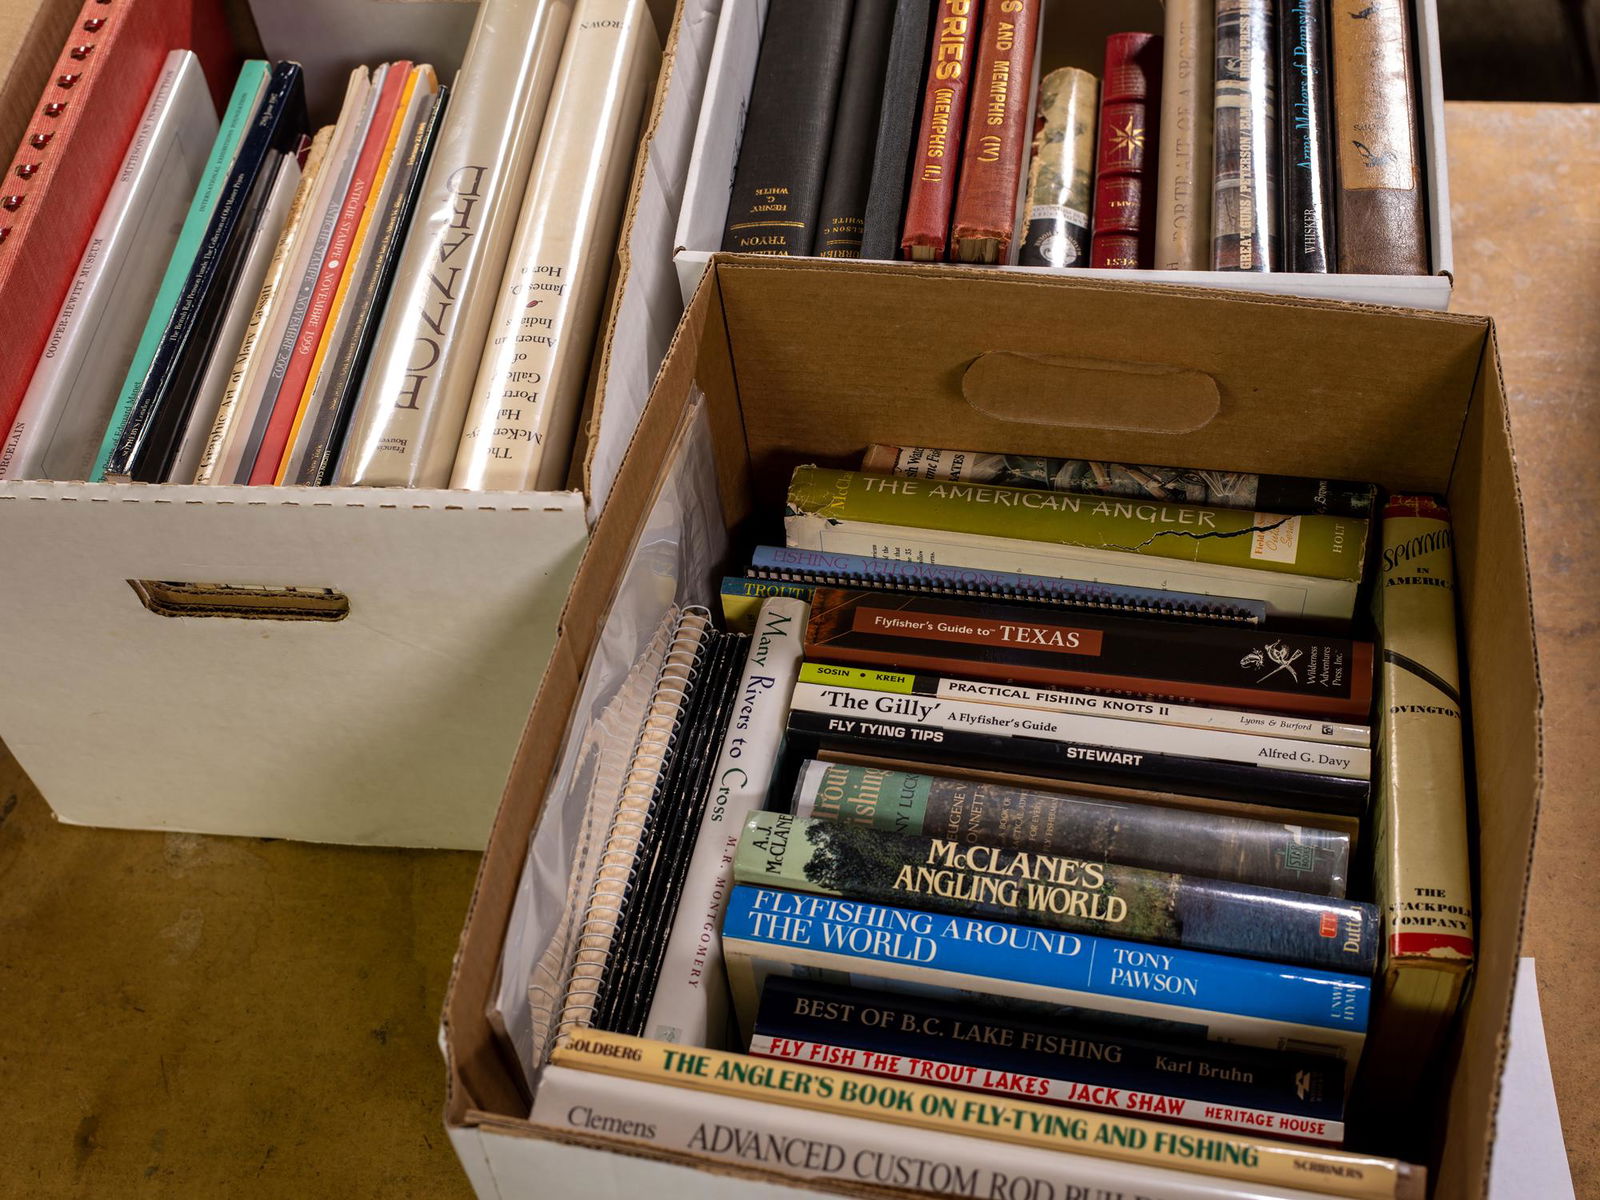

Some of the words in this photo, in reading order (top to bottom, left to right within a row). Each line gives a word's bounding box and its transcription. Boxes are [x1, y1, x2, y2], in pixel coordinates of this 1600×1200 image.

[580, 20, 624, 32] ROWN
[936, 0, 970, 80] PRIES
[996, 21, 1015, 51] AND
[1240, 16, 1252, 46] PRESS
[1292, 0, 1317, 57] Pennsyl
[1293, 61, 1317, 80] of
[987, 60, 1010, 126] MEMPHIS
[1293, 81, 1312, 129] Makers
[121, 123, 150, 182] SMITHSONIAN
[147, 70, 174, 122] INSTITUTION
[928, 88, 954, 158] (MEMPHIS
[977, 135, 1002, 162] (IV)
[1297, 131, 1312, 170] Arms
[344, 179, 365, 220] ANTICHE
[750, 205, 787, 213] HENRY
[756, 187, 788, 195] WHITE
[320, 201, 340, 240] ANTICHE
[332, 221, 351, 258] STAMPE
[1305, 208, 1315, 254] WHISKER
[740, 235, 786, 246] TRYON
[1240, 231, 1252, 269] GREAT
[305, 241, 327, 282] STAMPE
[520, 266, 561, 276] Horn
[46, 279, 85, 359] COOPER-HEWITT
[80, 238, 103, 277] MUSEUM
[310, 273, 334, 327] NOVEMBRE
[529, 283, 566, 297] James
[281, 294, 308, 349] NOVEMBRE
[506, 317, 553, 328] Indias
[300, 331, 315, 355] 1999
[513, 352, 527, 364] of
[201, 415, 227, 469] Graphic
[222, 395, 235, 408] Art
[232, 370, 242, 383] of
[237, 335, 256, 363] Mary
[250, 285, 272, 327] Cassatt
[272, 353, 289, 378] 2002
[487, 391, 539, 402] Portrt
[0, 422, 25, 480] ORCELAIN
[863, 477, 919, 496] THE
[928, 483, 1080, 513] AMERICAN
[1092, 501, 1216, 528] ANGLER
[1333, 523, 1345, 553] HOLT
[771, 549, 848, 569] FISHING
[862, 560, 1004, 588] YELLOWSTONE
[744, 583, 804, 599] TROUT
[752, 611, 792, 668] Many
[875, 616, 933, 631] Flyfisher's
[938, 622, 973, 635] Guide
[1000, 625, 1080, 648] TEXAS
[817, 667, 850, 677] SOSIN
[876, 673, 905, 684] KREH
[1306, 646, 1318, 685] Wilderness
[1320, 646, 1331, 687] Adventures
[736, 675, 775, 730] Rivers
[949, 682, 1030, 700] PRACTICAL
[1036, 692, 1097, 707] FISHING
[1103, 701, 1153, 714] KNOTS
[1159, 707, 1169, 716] II
[1390, 705, 1462, 718] OVINGTON
[948, 712, 957, 721] A
[960, 712, 1020, 728] Flyfisher's
[1022, 720, 1057, 733] Guide
[1240, 715, 1265, 727] Lyons
[1280, 721, 1312, 732] Burford
[729, 738, 747, 759] to
[829, 719, 853, 732] FLY
[860, 723, 906, 738] TYING
[911, 728, 944, 743] TIPS
[1066, 746, 1143, 767] STEWART
[1258, 747, 1297, 761] Alfred
[1300, 752, 1315, 763] G.
[1318, 754, 1351, 770] Davy
[712, 768, 748, 822] Cross
[854, 768, 893, 824] ishing
[900, 773, 919, 808] LUCK
[947, 792, 965, 841] EUGENE
[753, 826, 772, 850] A.J.
[766, 814, 794, 875] McCLANE
[926, 838, 1104, 889] McCLANE'S
[893, 864, 1019, 907] ANGLING
[1027, 883, 1128, 923] WORLD
[1389, 902, 1472, 917] SACKPOL
[1415, 888, 1446, 898] THE
[688, 877, 726, 989] MONTGOMERY
[748, 911, 812, 944] THE
[822, 922, 937, 963] WORLD
[752, 890, 933, 934] FLYFISHING
[940, 918, 1082, 957] AROUND
[1343, 906, 1363, 954] Duttn
[1392, 917, 1468, 931] COMPANY
[1113, 949, 1174, 971] TONY
[1110, 967, 1199, 996] PAWSON
[565, 1037, 643, 1062] GOLDBERG
[794, 998, 854, 1023] BEST
[861, 1008, 896, 1027] OF
[901, 1015, 944, 1036] B.C.
[952, 1022, 1014, 1047] LAKE
[1022, 1032, 1123, 1063] FISHING
[769, 1038, 804, 1057] FLY
[809, 1044, 856, 1068] FISH
[863, 1052, 902, 1073] THE
[909, 1058, 977, 1084] TROUT
[983, 1071, 1050, 1096] LAKES
[1068, 1083, 1120, 1107] JACK
[1127, 1092, 1186, 1116] SHAW
[1156, 1056, 1192, 1074] Karl
[1199, 1062, 1254, 1084] Bruhn
[567, 1105, 657, 1140] Clemens
[662, 1049, 711, 1077] THE
[714, 1059, 833, 1101] ANGLER'S
[840, 1080, 914, 1112] BOOK
[921, 1094, 955, 1120] ON
[962, 1101, 1087, 1142] FLY-TYING
[1094, 1123, 1147, 1151] AND
[1154, 1131, 1260, 1168] FISHING
[1204, 1106, 1274, 1127] HERITAGE
[1279, 1118, 1326, 1135] HOUSE
[687, 1122, 846, 1174] ADVANCED
[854, 1148, 979, 1196] CUSTOM
[990, 1171, 1054, 1200] ROD
